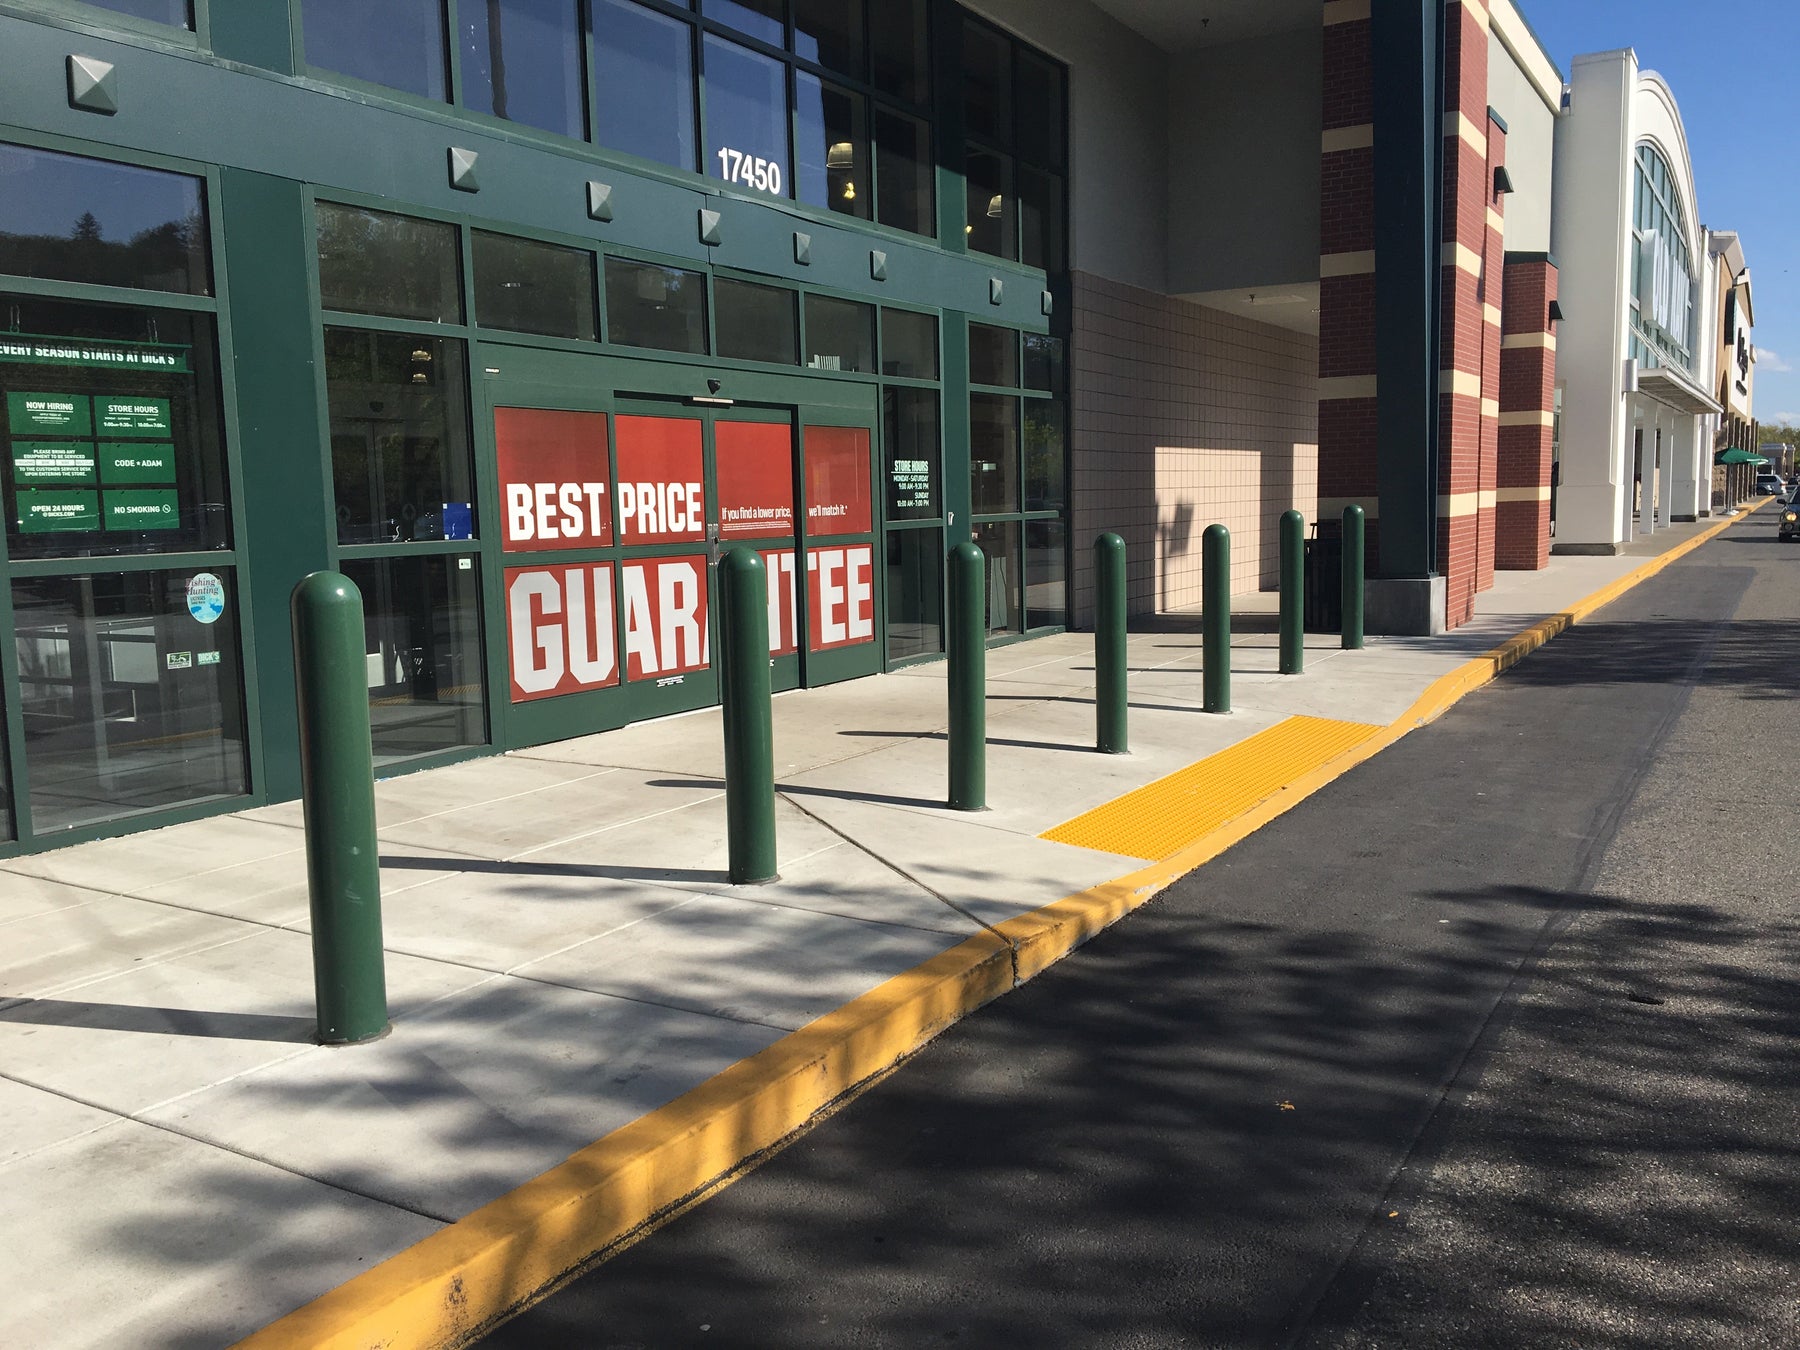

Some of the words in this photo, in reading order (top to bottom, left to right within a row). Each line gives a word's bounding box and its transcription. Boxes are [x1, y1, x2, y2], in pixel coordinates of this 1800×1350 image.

[718, 147, 780, 195] 17450
[35, 344, 80, 358] SEASON
[82, 347, 124, 361] STARTS
[126, 350, 138, 362] AT
[26, 401, 45, 409] NOW
[47, 402, 74, 411] HIRING
[108, 404, 133, 412] STORE
[134, 405, 159, 413] HOURS
[114, 459, 135, 467] CODE
[141, 459, 163, 467] ADAM
[894, 460, 911, 472] STORE
[911, 460, 929, 472] HOURS
[126, 505, 160, 513] SMOKING
[506, 482, 605, 541] BEST
[618, 482, 703, 534] PRICE
[721, 507, 728, 520] If
[728, 508, 739, 521] you
[740, 506, 752, 519] find
[753, 508, 758, 518] a
[758, 506, 774, 518] lower
[775, 505, 792, 520] price,
[808, 505, 821, 517] we'll
[822, 504, 839, 516] match
[509, 547, 874, 694] GUARTEE
